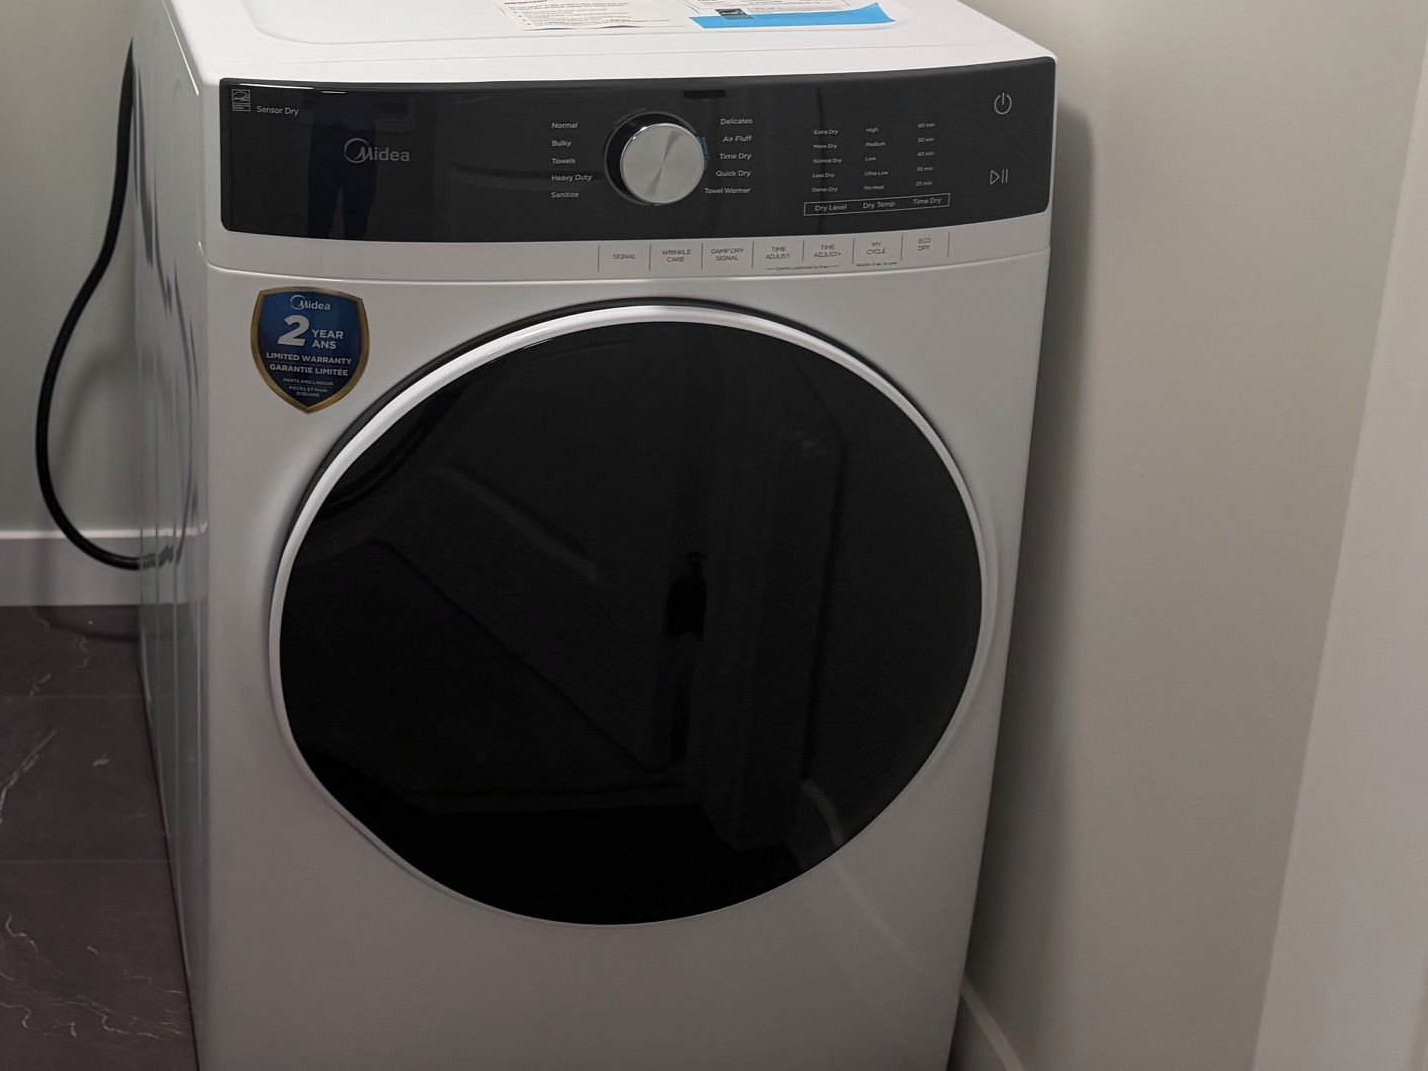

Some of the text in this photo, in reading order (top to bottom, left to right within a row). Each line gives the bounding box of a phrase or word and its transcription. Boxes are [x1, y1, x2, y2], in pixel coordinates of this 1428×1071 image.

[257, 106, 299, 116] Sensor Dry
[344, 137, 410, 163] Midea
[552, 174, 574, 182] Heavy
[738, 170, 751, 178] Dry
[876, 201, 895, 209] Temp
[290, 295, 330, 310] Midea
[277, 315, 344, 346] 2 YEAR
[312, 340, 336, 349] ANS
[266, 352, 352, 365] LIMITED WARRANTY
[270, 364, 348, 376] GARANTIE LIMITÉE
